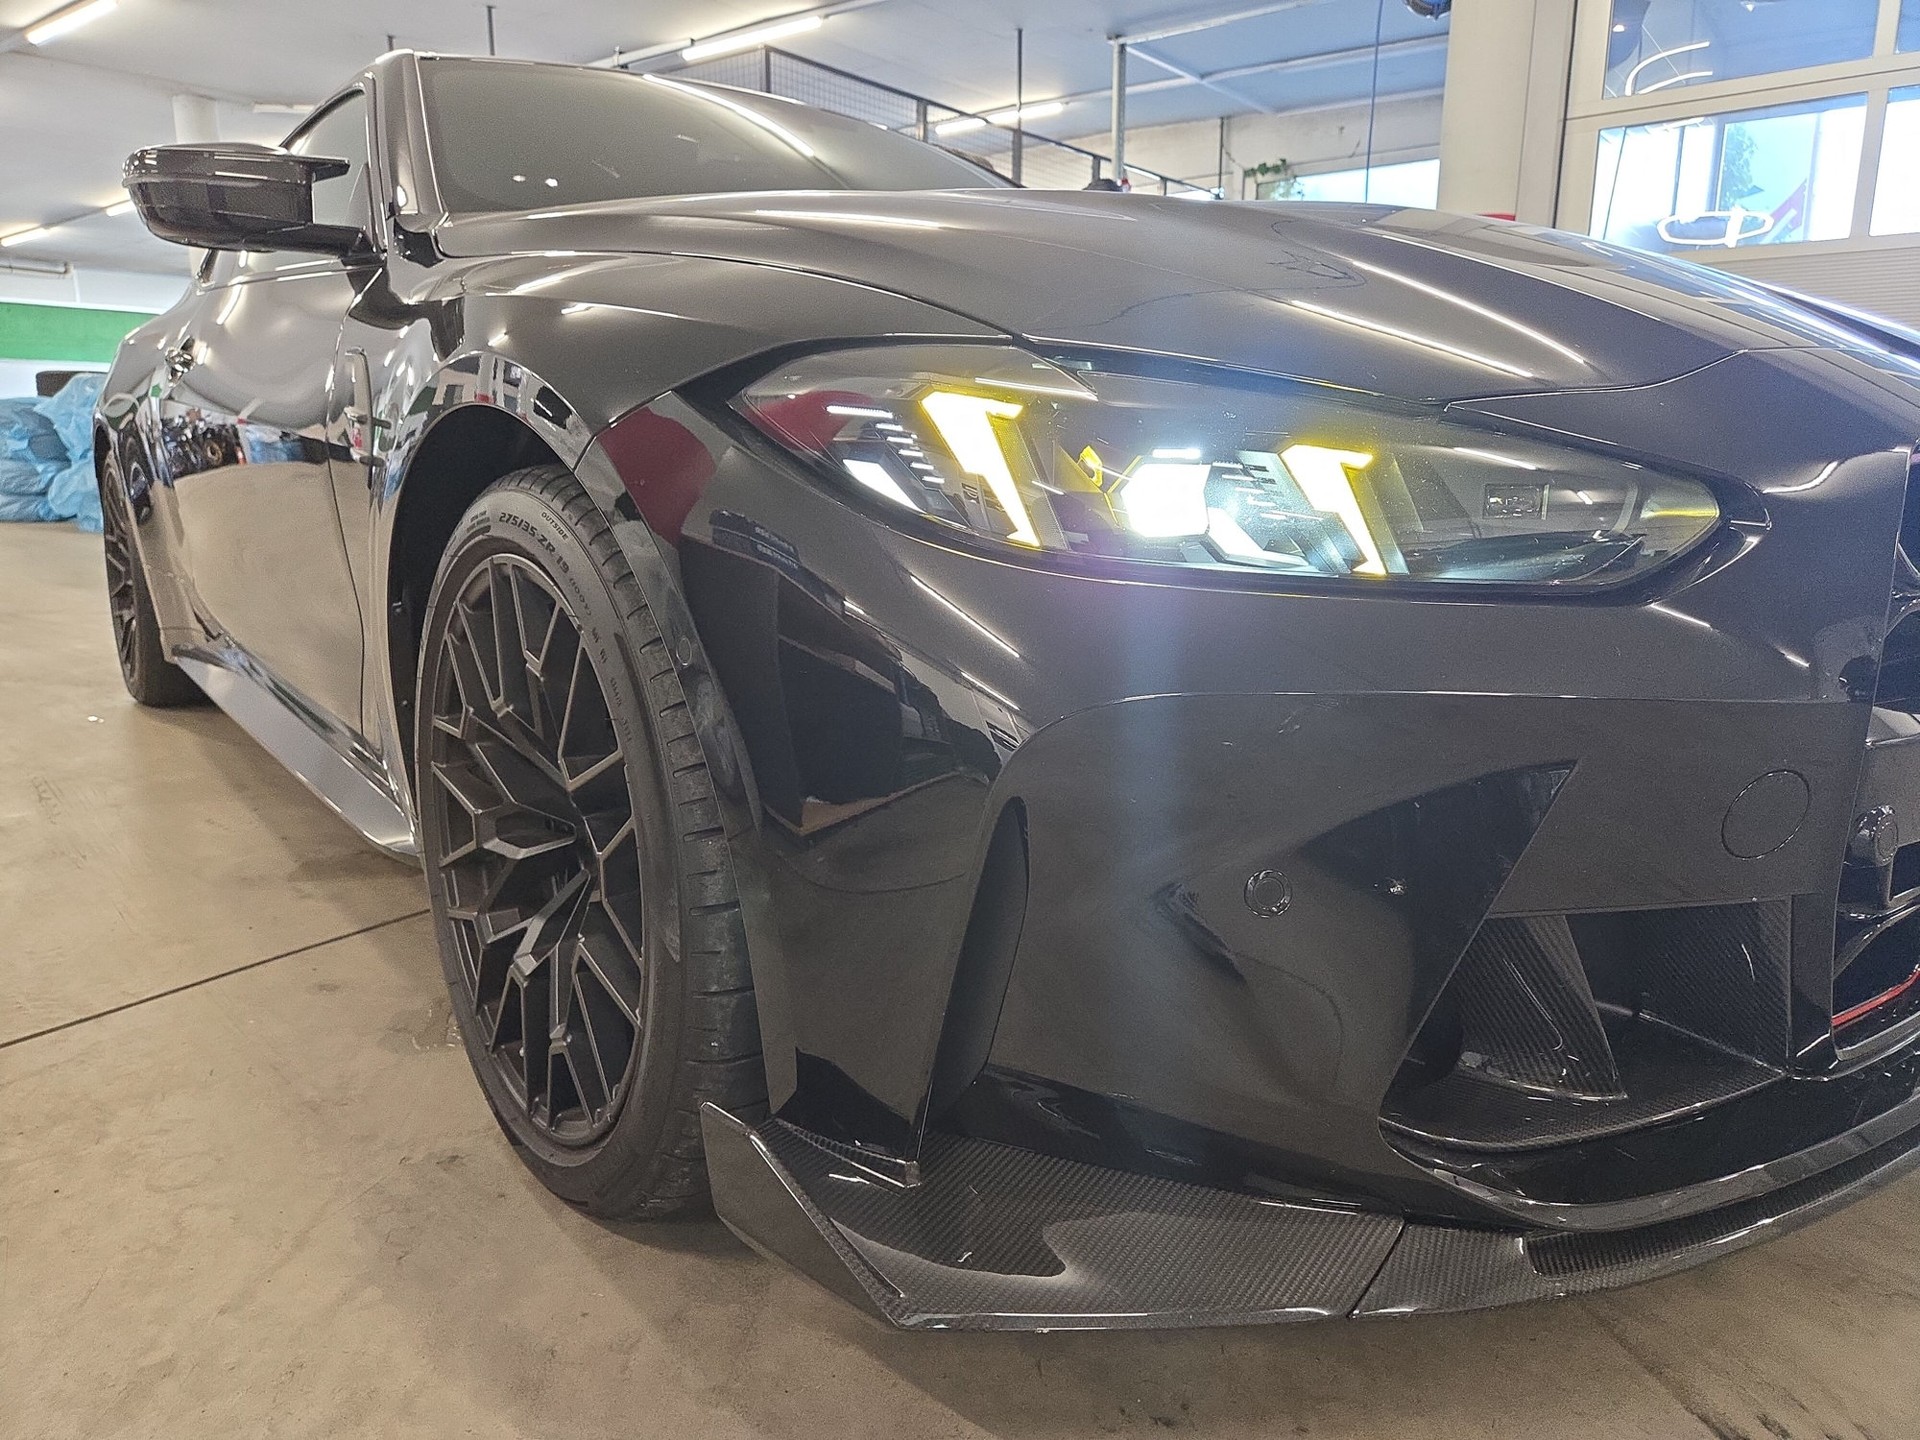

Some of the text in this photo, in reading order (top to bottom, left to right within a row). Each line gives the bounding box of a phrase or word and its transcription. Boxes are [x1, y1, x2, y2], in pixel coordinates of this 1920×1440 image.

[499, 512, 538, 537] 275/35
[537, 534, 556, 553] ZR
[541, 511, 569, 541] OUTSIDE
